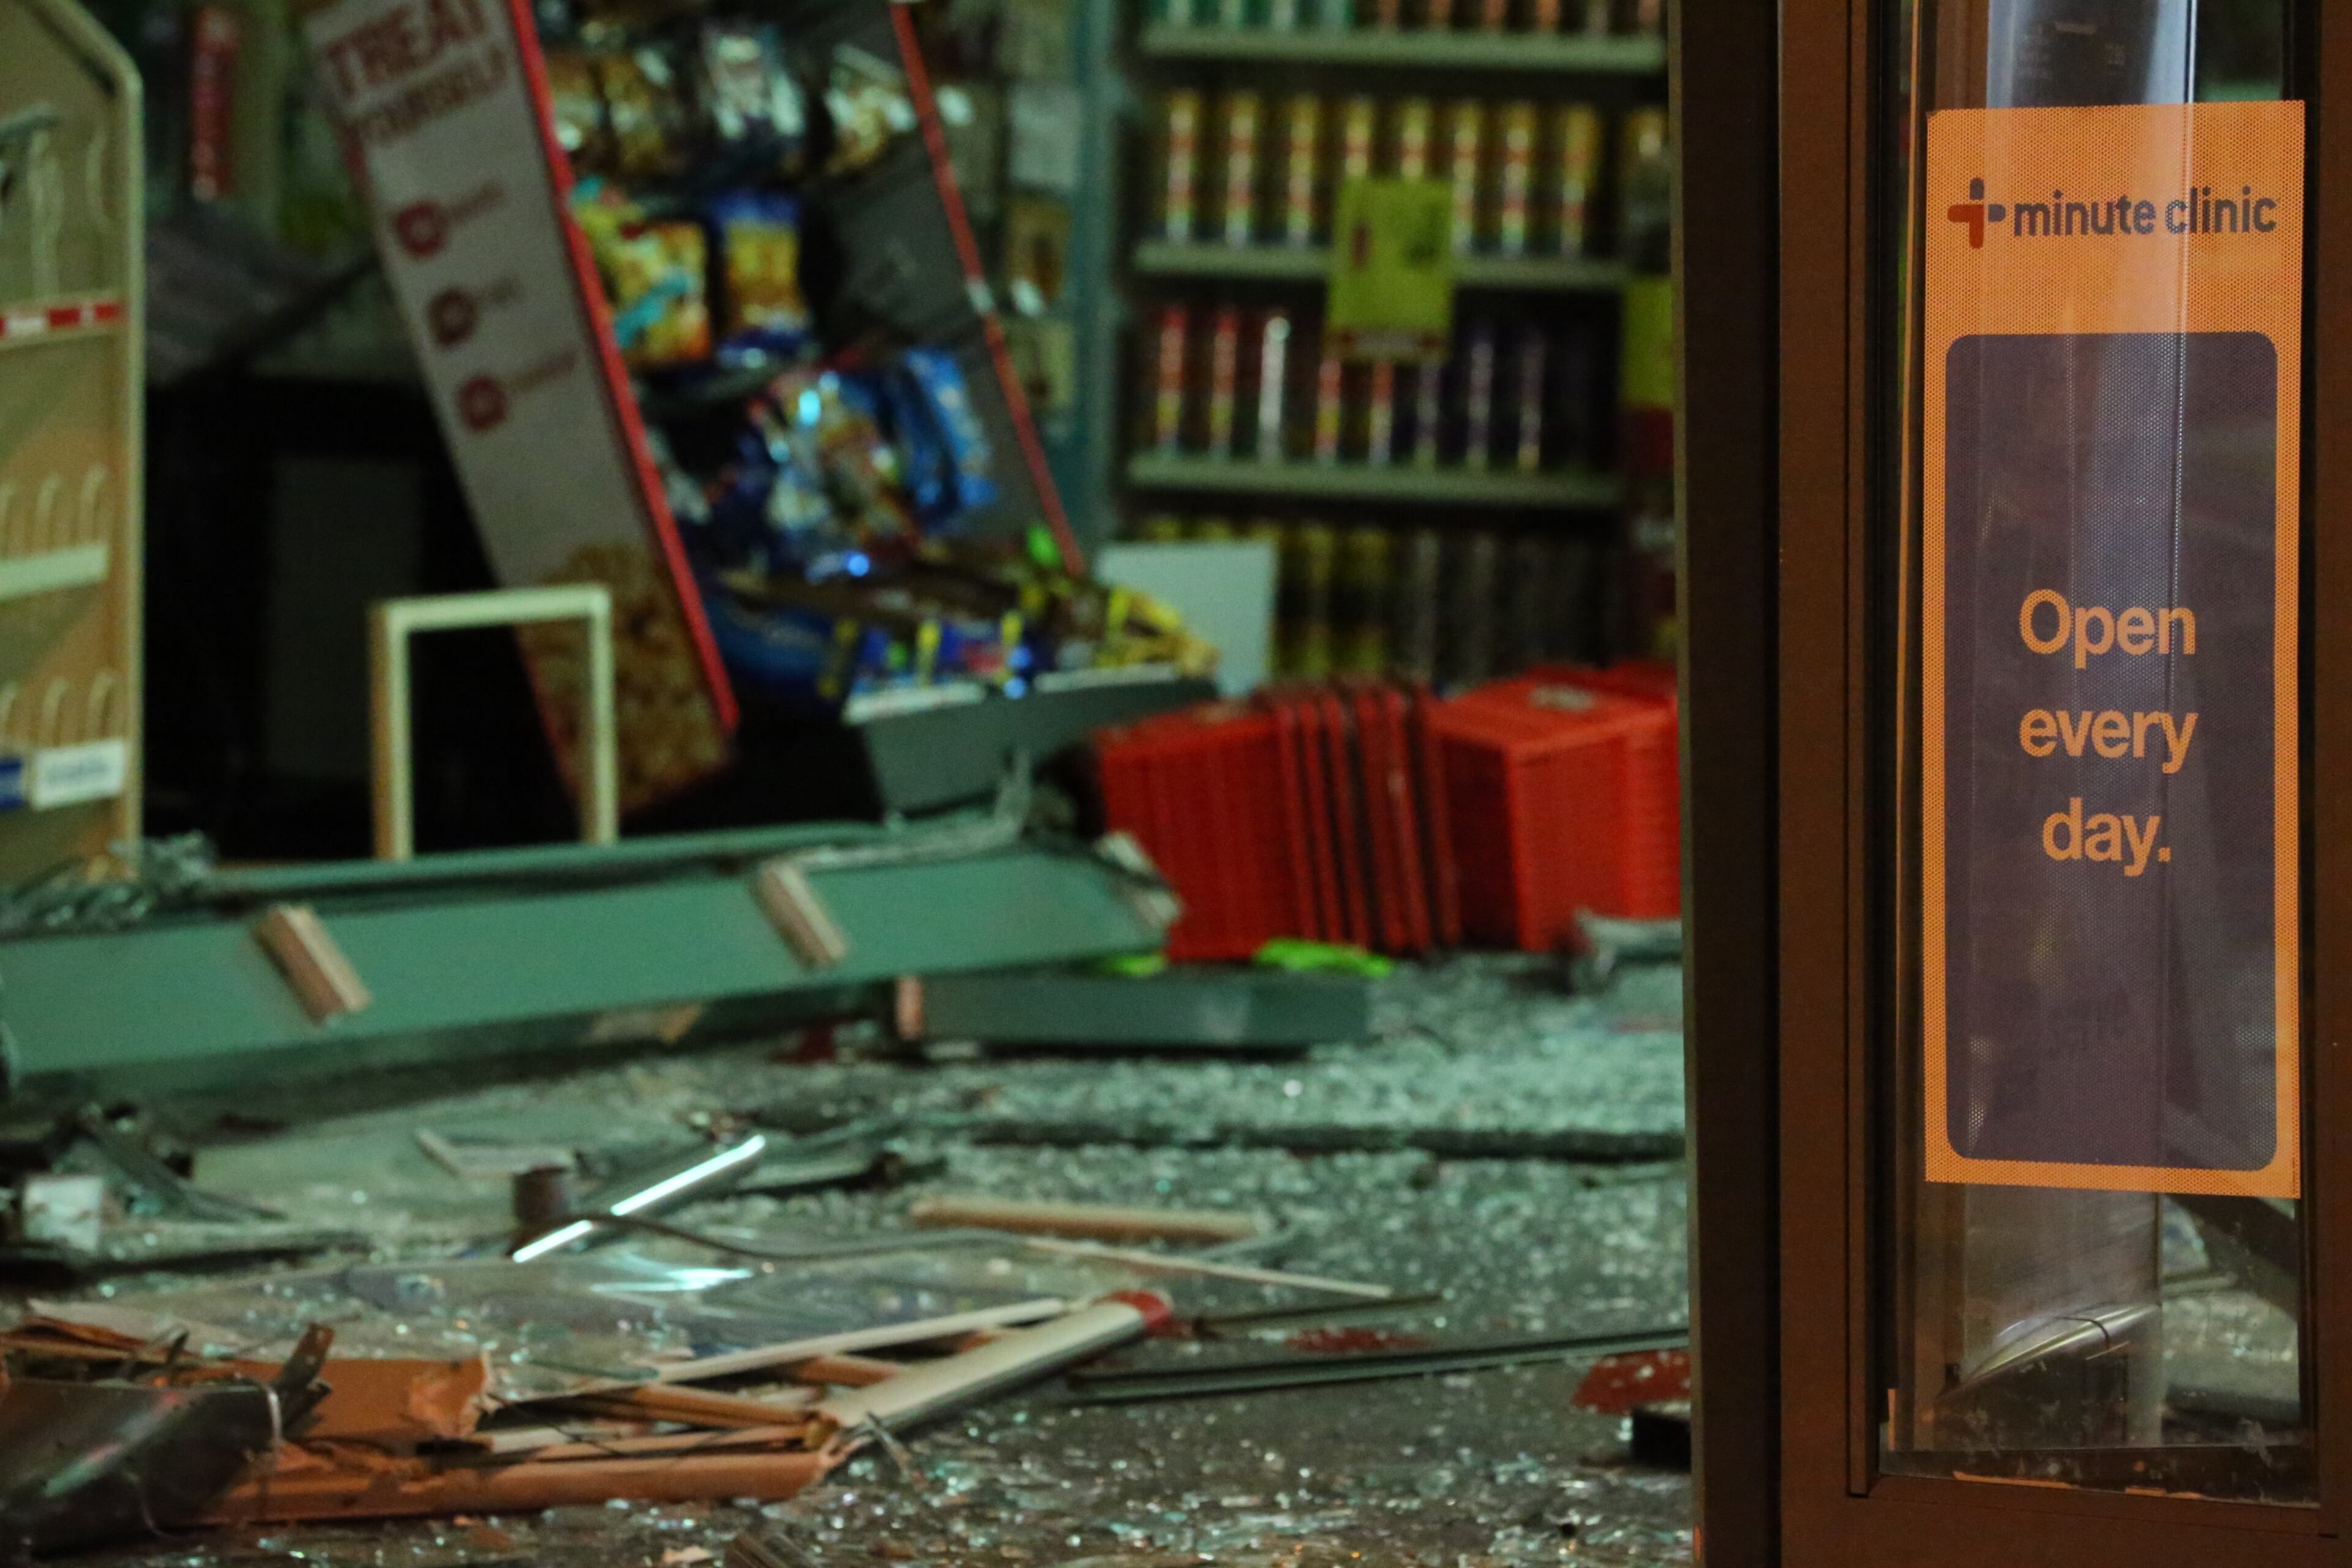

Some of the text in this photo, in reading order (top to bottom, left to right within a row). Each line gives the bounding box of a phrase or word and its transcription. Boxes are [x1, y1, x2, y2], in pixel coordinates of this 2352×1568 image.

[2013, 185, 2278, 236] minute clinic
[2019, 589, 2196, 669] Open
[2019, 709, 2199, 774] every
[2043, 797, 2171, 877] day.
